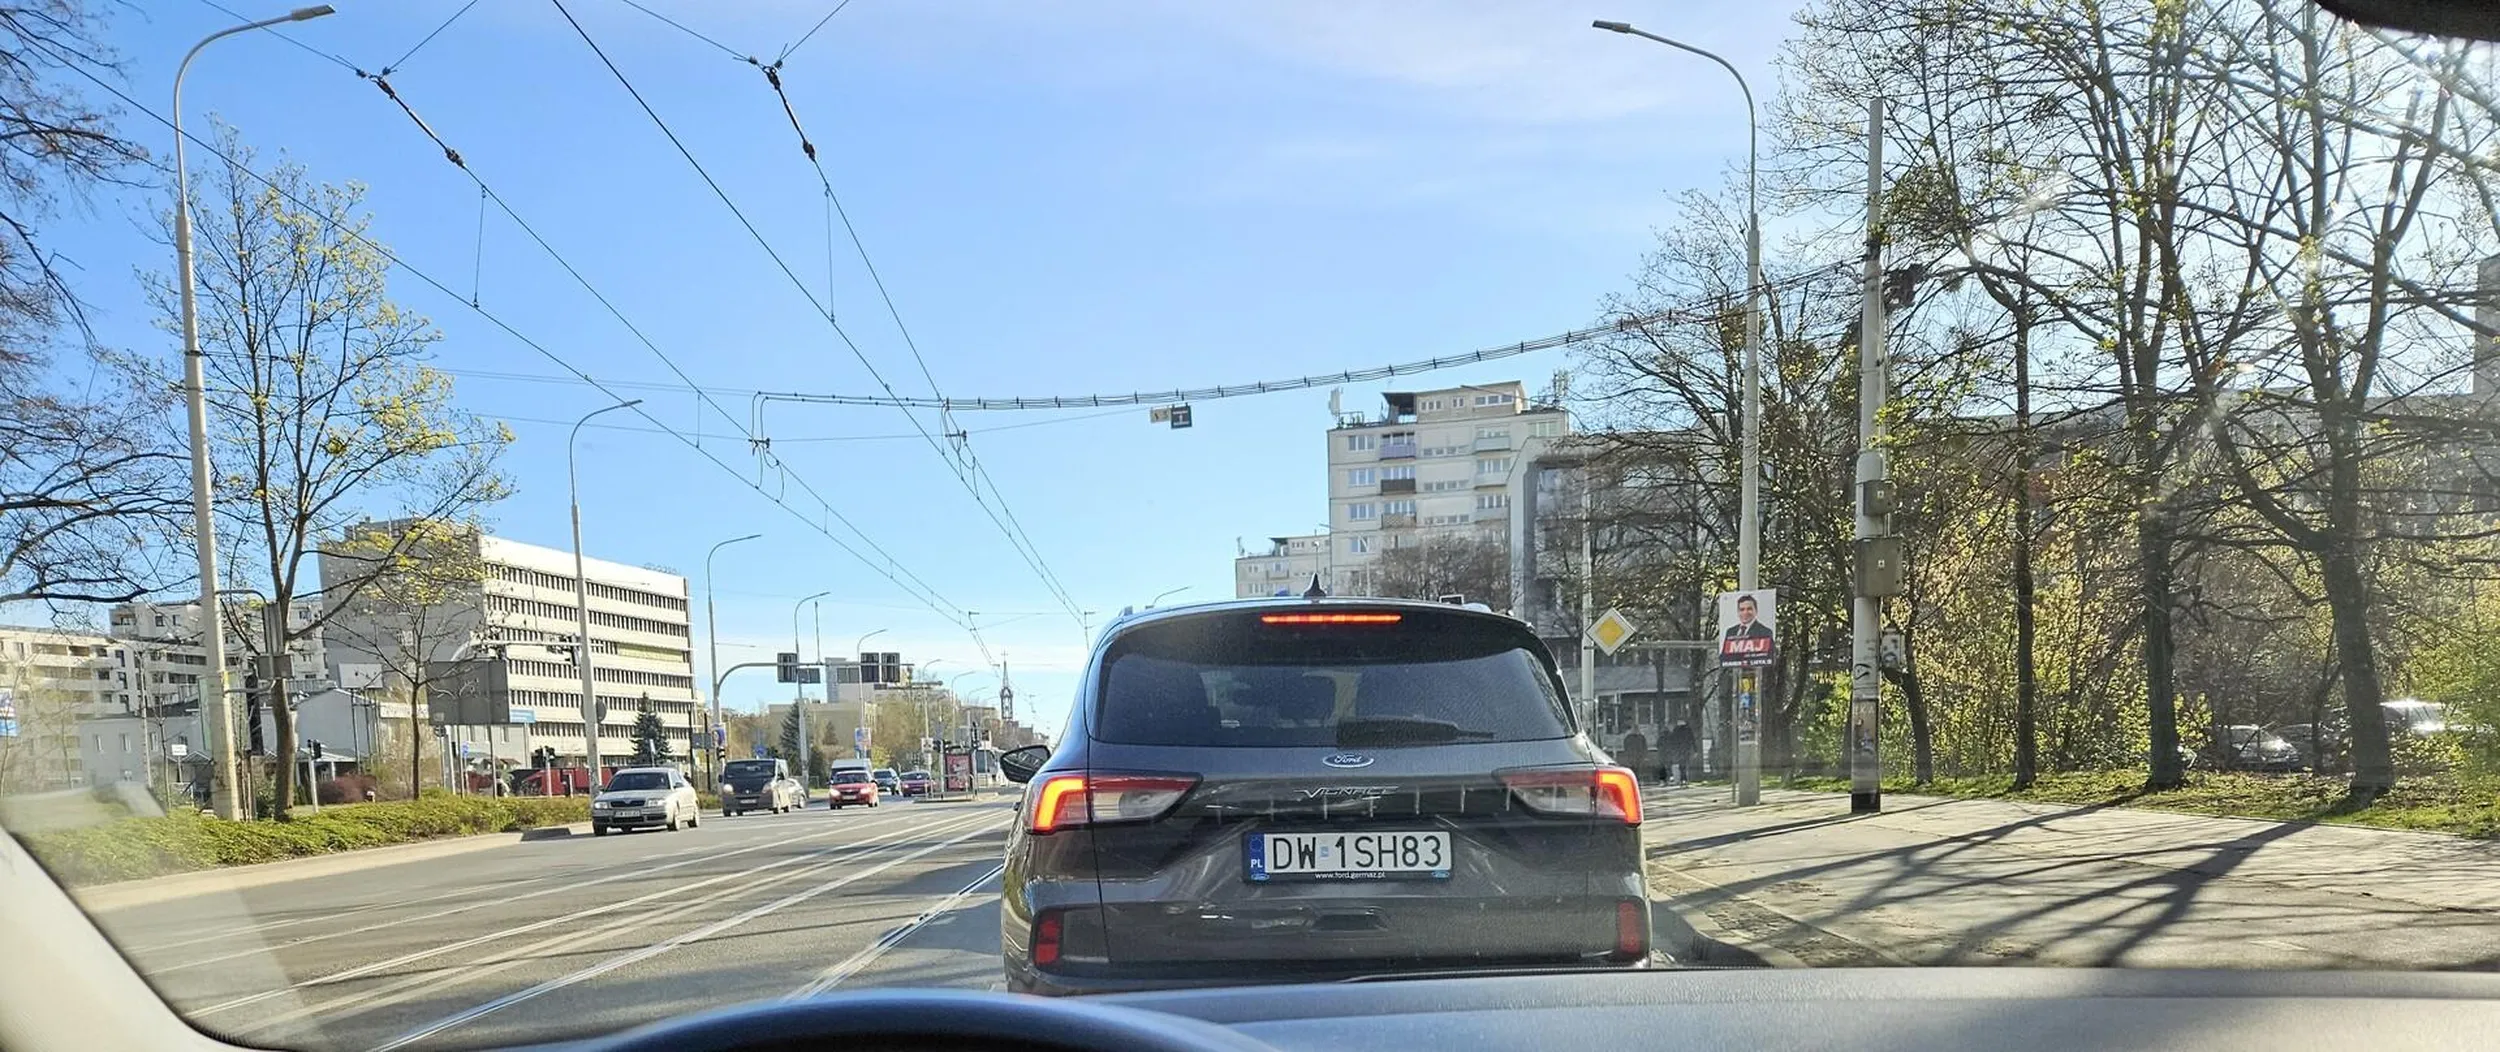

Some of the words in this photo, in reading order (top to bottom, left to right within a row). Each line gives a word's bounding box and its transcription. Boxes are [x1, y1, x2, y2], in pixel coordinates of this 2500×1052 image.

[1729, 638, 1765, 653] MAJ
[1273, 837, 1316, 869] DW
[1334, 835, 1442, 868] 1SH83
[1250, 858, 1264, 869] PL
